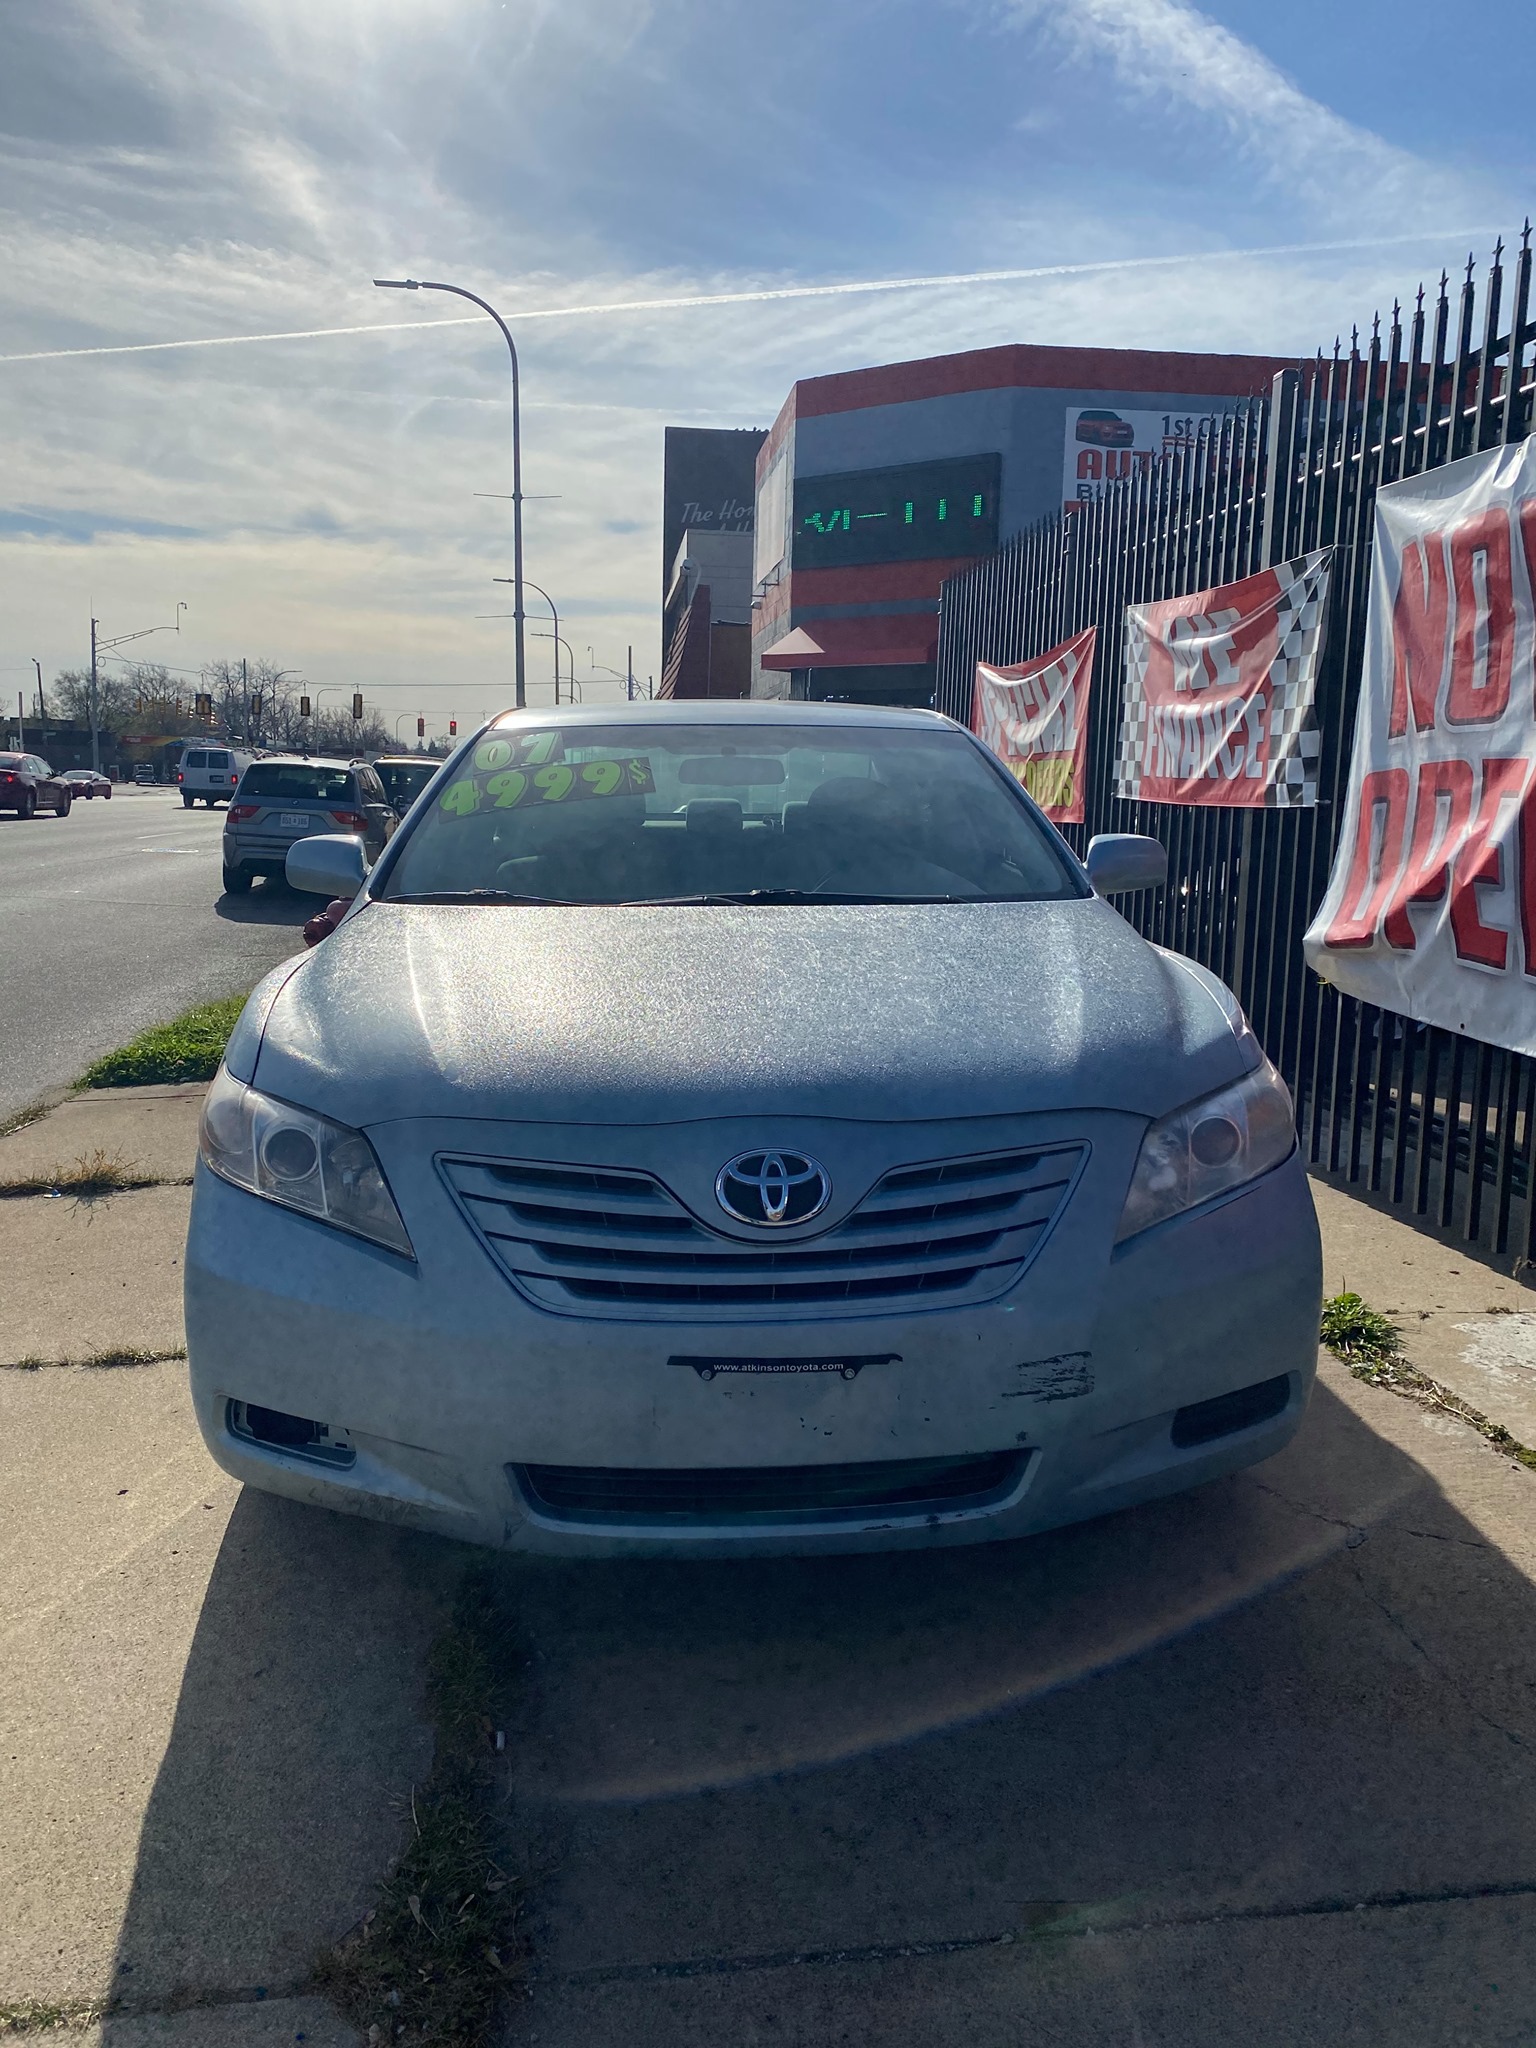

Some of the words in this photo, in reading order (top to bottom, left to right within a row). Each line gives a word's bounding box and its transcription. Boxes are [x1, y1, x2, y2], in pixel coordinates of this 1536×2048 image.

[1162, 415, 1193, 436] 1st
[681, 502, 713, 523] The
[1163, 606, 1242, 691] WE
[1387, 498, 1536, 738] NO
[473, 731, 561, 771] 07
[1143, 694, 1267, 780] FINANCE
[1325, 757, 1536, 978] OPE
[713, 1362, 844, 1373] www.atkinsontoyota.com
